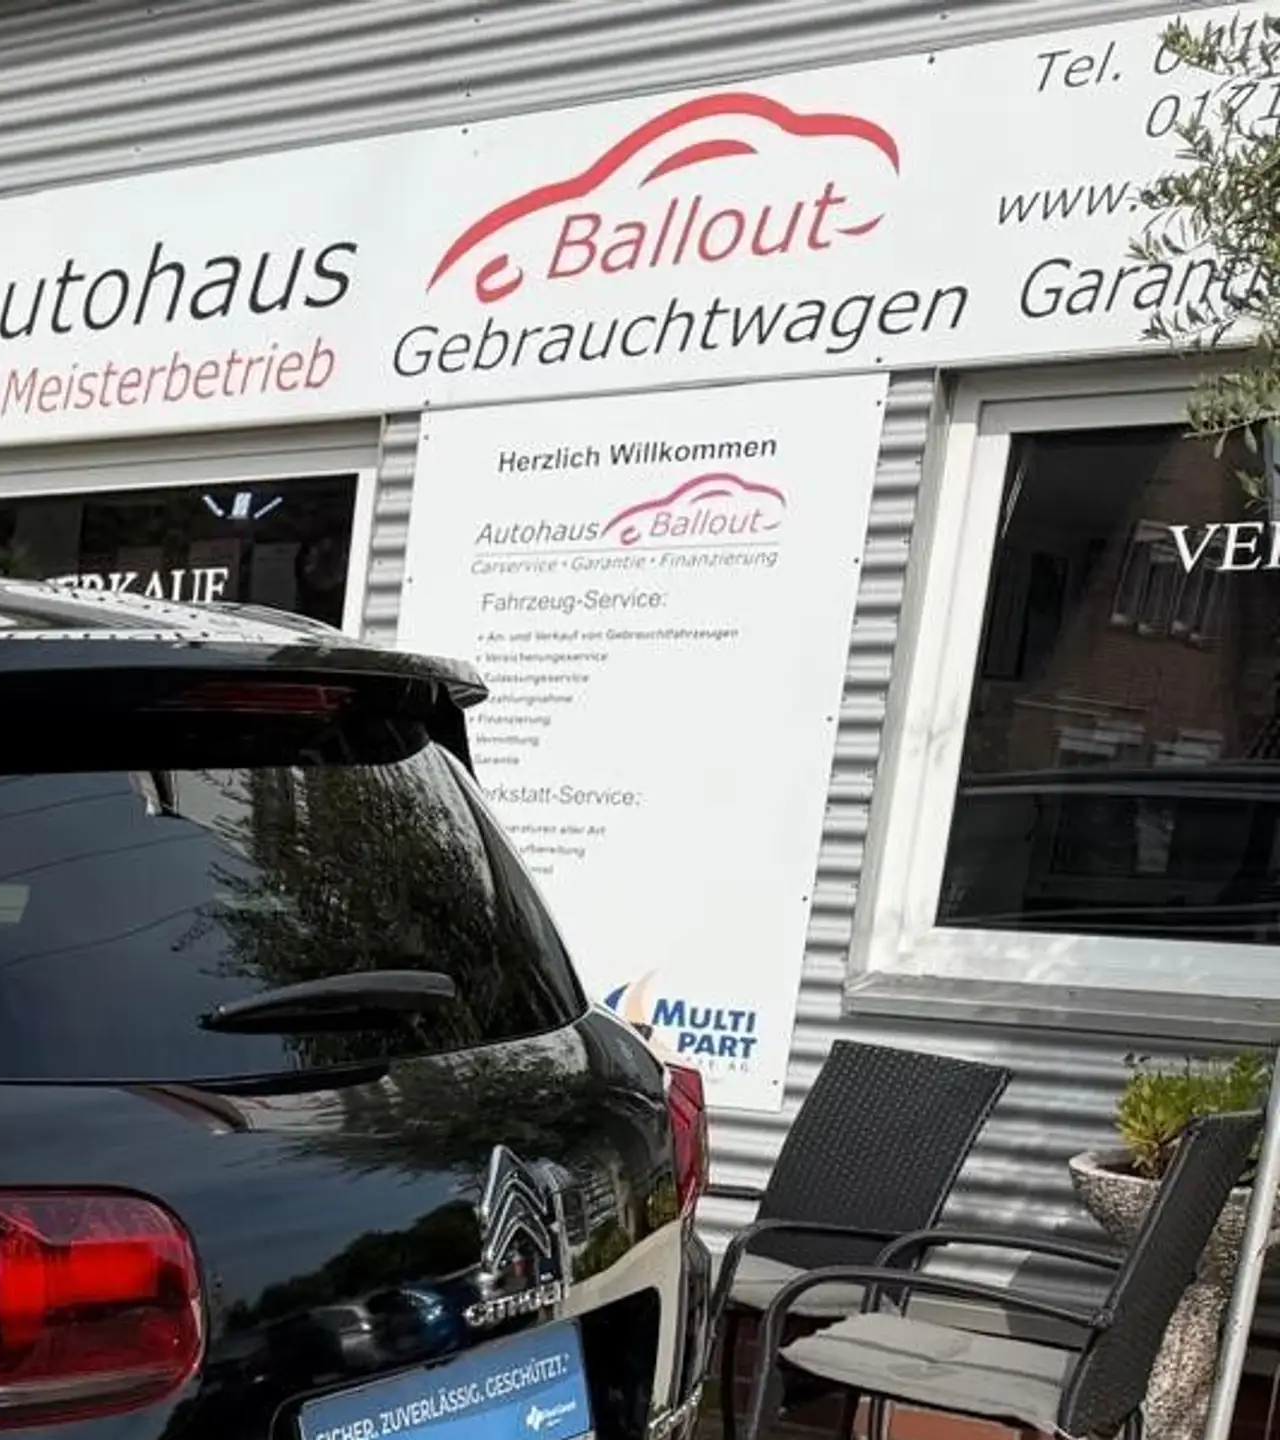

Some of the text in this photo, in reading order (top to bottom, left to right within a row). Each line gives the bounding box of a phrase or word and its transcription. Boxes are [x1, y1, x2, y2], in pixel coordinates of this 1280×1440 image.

[1037, 41, 1121, 92] Tel.
[547, 181, 846, 281] Ballout
[392, 281, 968, 380] Gebrauchtwagen
[497, 438, 777, 474] Herzlich Willkommen
[474, 520, 599, 546] Autohaus
[648, 509, 764, 538] Ballout
[471, 550, 778, 575] Carservice Garantie Finanzierung
[481, 588, 667, 614] Fahrzeug-Service:
[481, 784, 643, 806] erkstatt-Service:
[652, 998, 756, 1032] MULTI
[677, 1031, 757, 1058] PART
